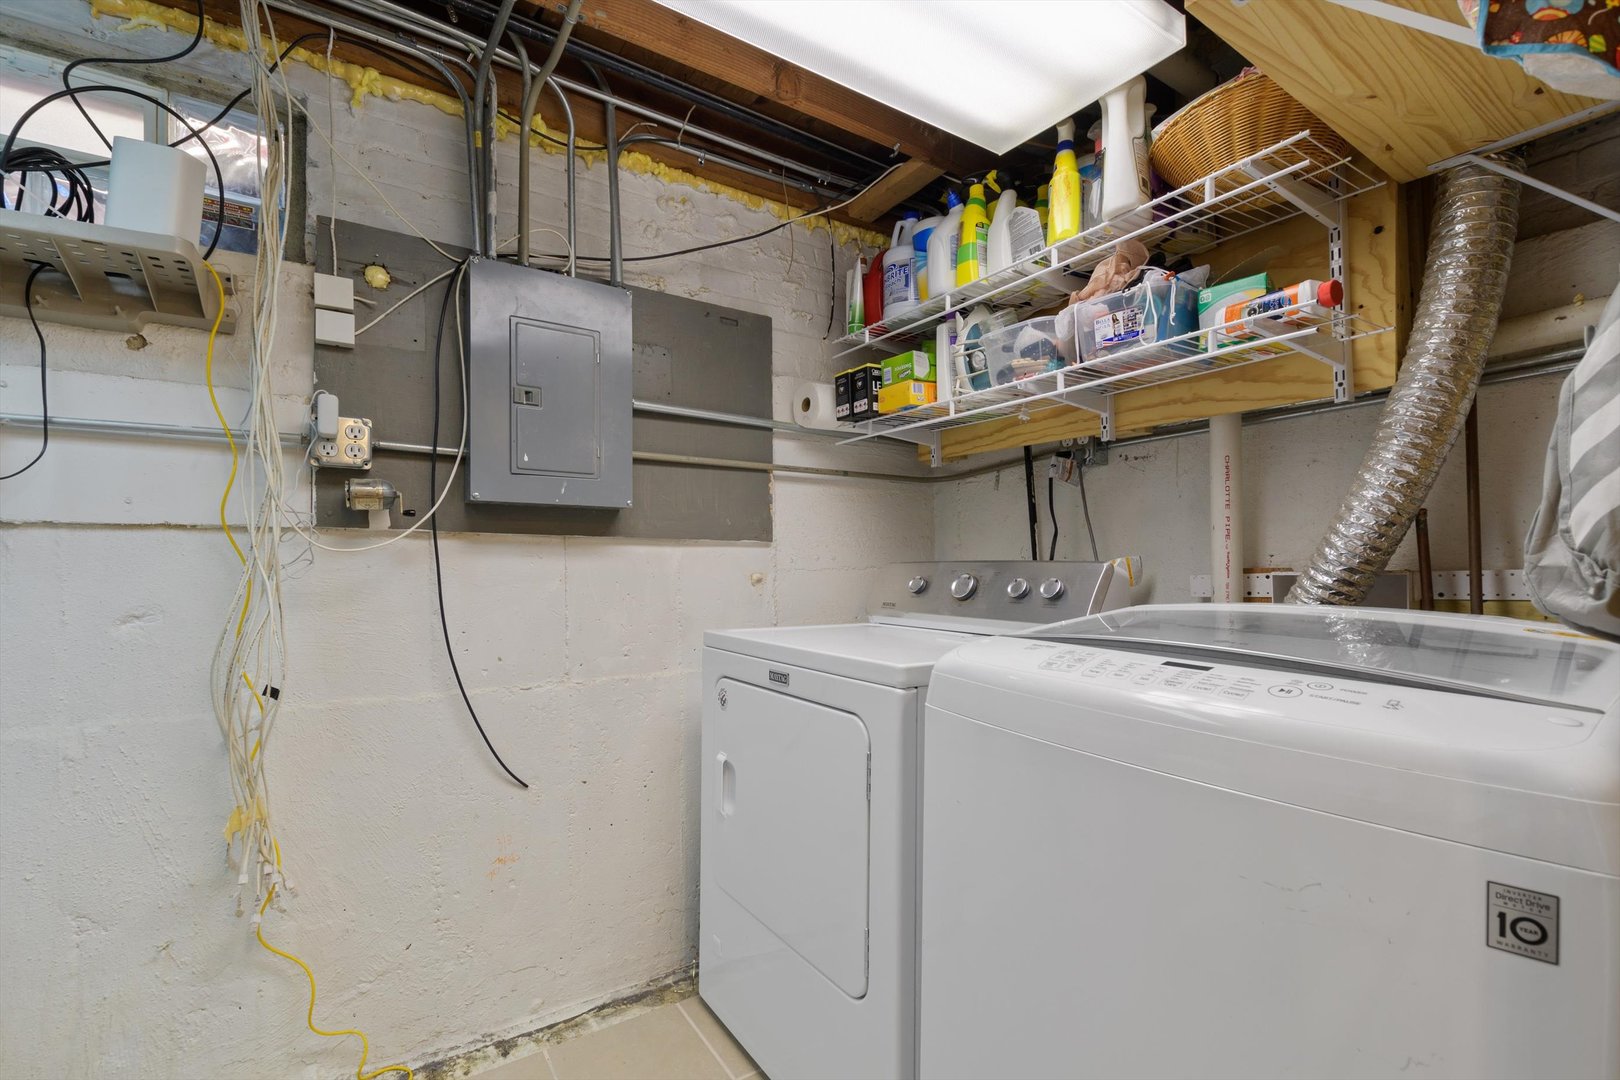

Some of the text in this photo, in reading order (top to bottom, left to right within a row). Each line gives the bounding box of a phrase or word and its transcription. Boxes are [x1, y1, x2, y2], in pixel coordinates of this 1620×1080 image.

[1495, 891, 1550, 911] Direct Drive
[1503, 889, 1542, 901] INVERTER
[1496, 911, 1549, 946] 10 YEAR
[1496, 940, 1549, 957] WARRANTY
